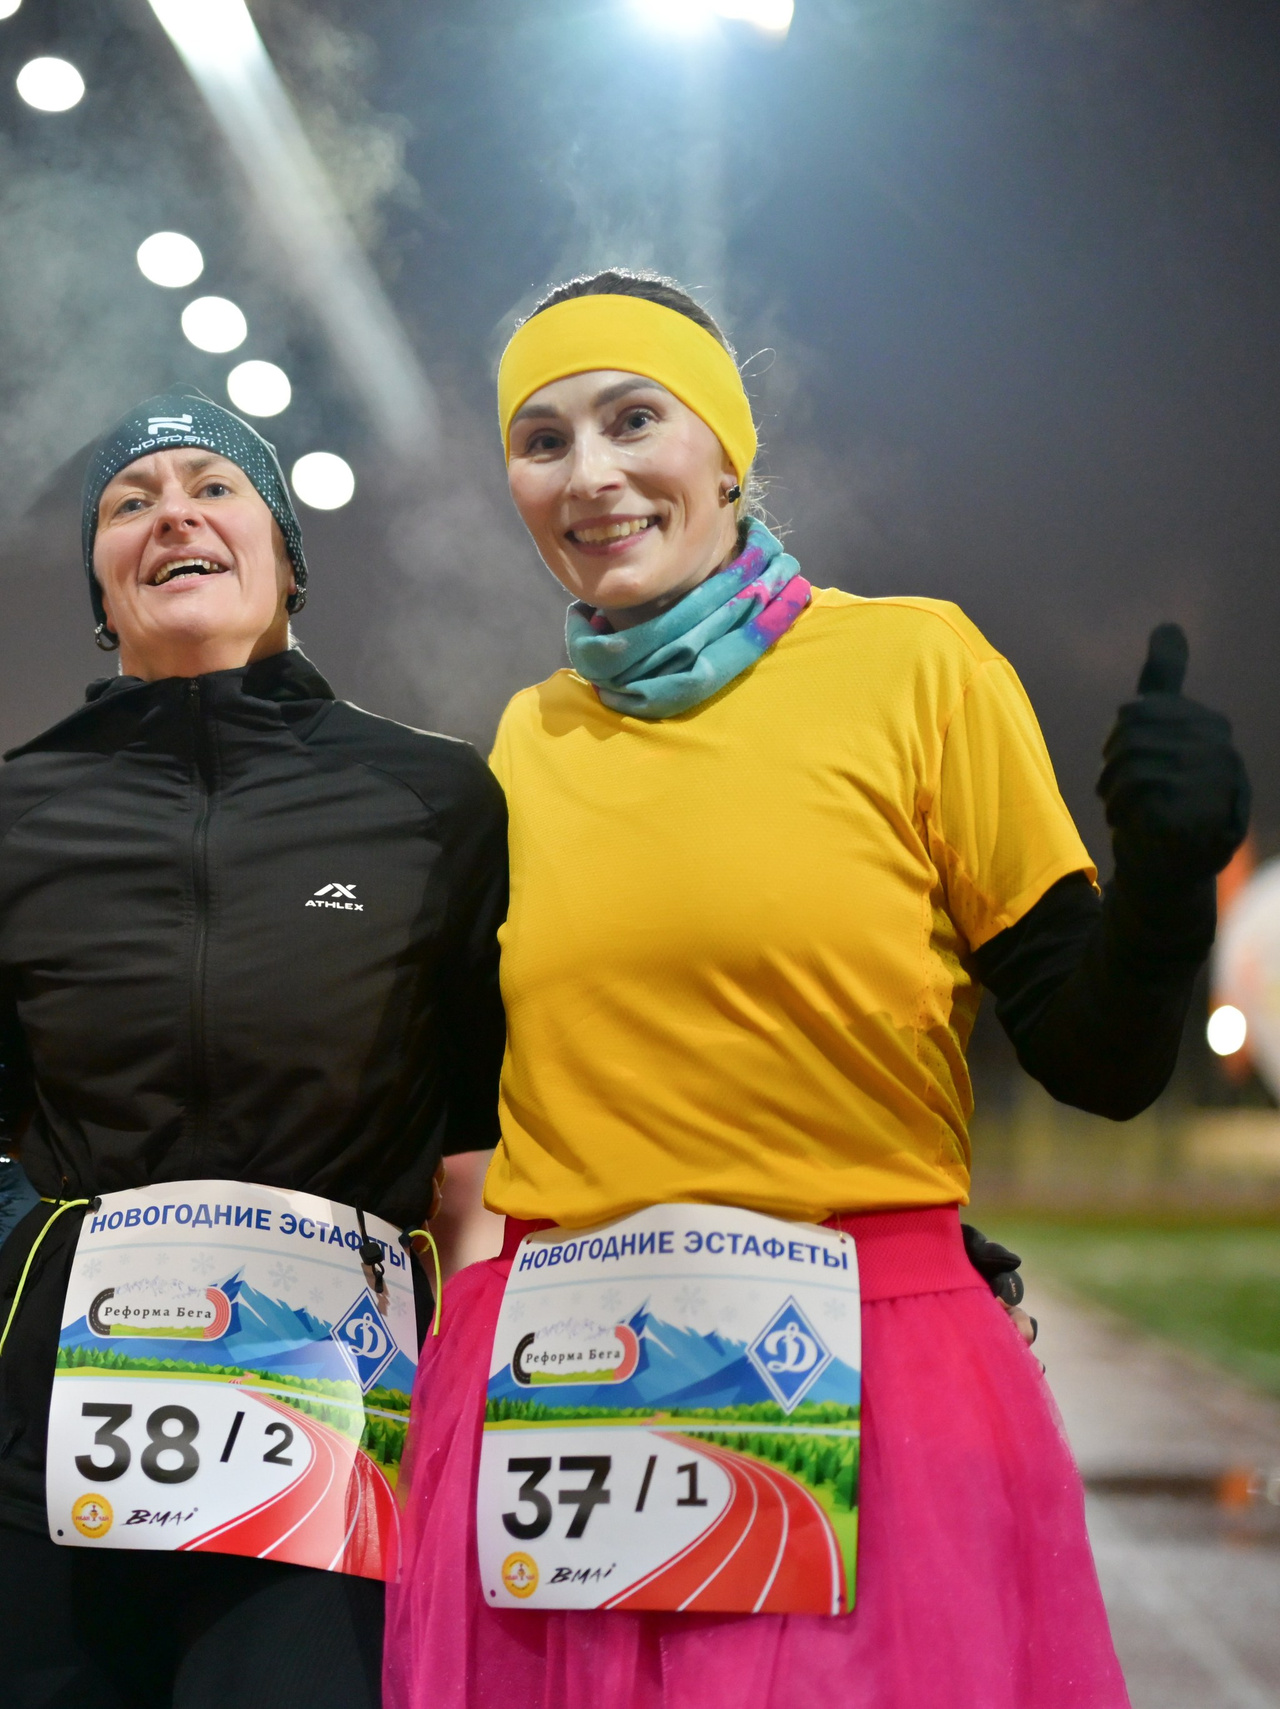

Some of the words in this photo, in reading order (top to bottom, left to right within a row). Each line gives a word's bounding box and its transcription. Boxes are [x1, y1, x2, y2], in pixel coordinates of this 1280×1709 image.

[304, 900, 364, 912] ATHLEX
[90, 1203, 272, 1235] НОВОГОДНИЕ
[279, 1213, 406, 1271] ЭСТАФТЫ
[519, 1231, 675, 1273] НОВОГОДНИЕ
[683, 1231, 849, 1270] ЭСТАФЕТЫ
[104, 1306, 170, 1319] Реформа
[176, 1307, 212, 1319] Бега
[526, 1351, 583, 1366] Реформа
[589, 1349, 621, 1360] Бега
